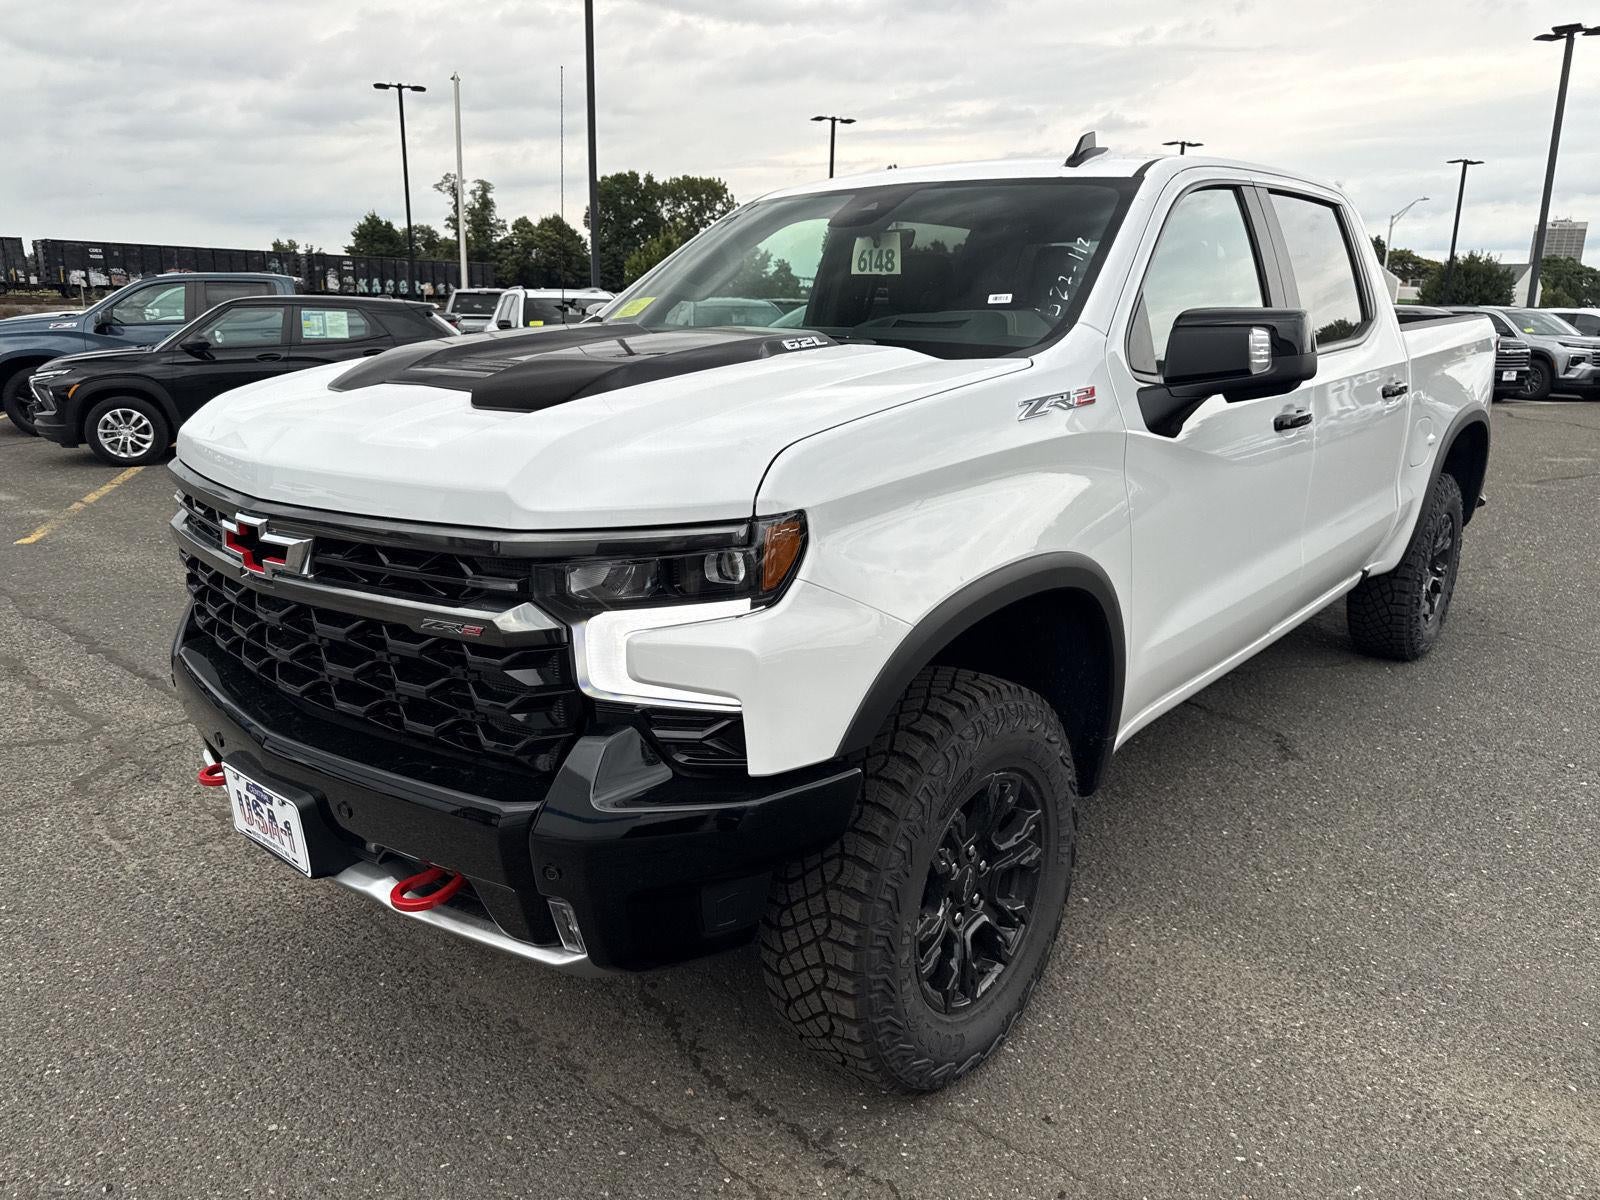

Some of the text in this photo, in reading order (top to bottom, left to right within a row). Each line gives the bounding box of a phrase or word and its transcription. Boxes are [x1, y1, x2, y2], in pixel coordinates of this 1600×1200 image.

[857, 248, 896, 273] 6148
[1017, 385, 1096, 421] ZR2
[420, 618, 486, 637] ZR2
[235, 788, 297, 854] USA-1
